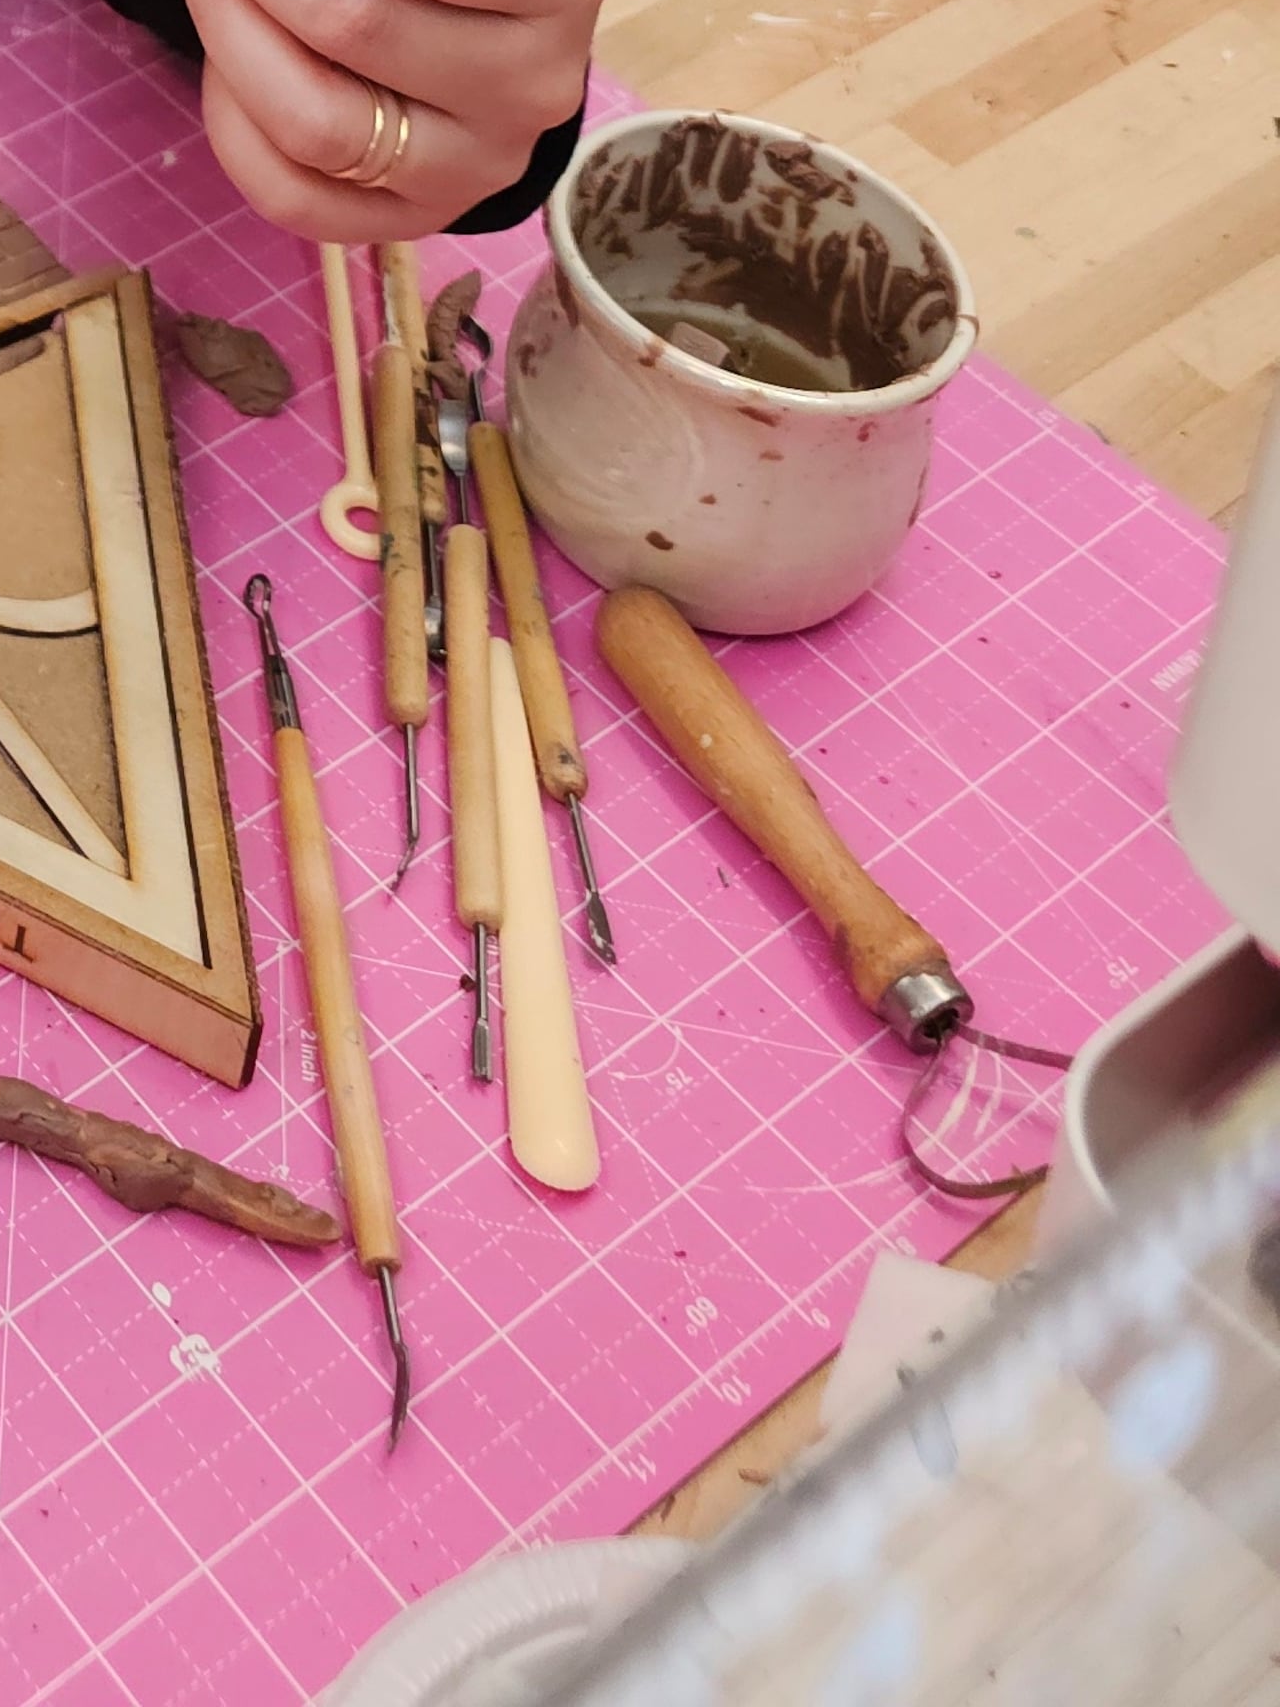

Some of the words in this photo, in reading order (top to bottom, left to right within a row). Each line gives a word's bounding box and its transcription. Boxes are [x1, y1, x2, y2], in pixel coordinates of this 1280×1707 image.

[1107, 955, 1139, 990] 75°
[300, 1028, 317, 1041] 2
[665, 1066, 694, 1097] 75°
[685, 1295, 720, 1337] 60°
[811, 1306, 831, 1331] 9
[722, 1375, 752, 1406] 10
